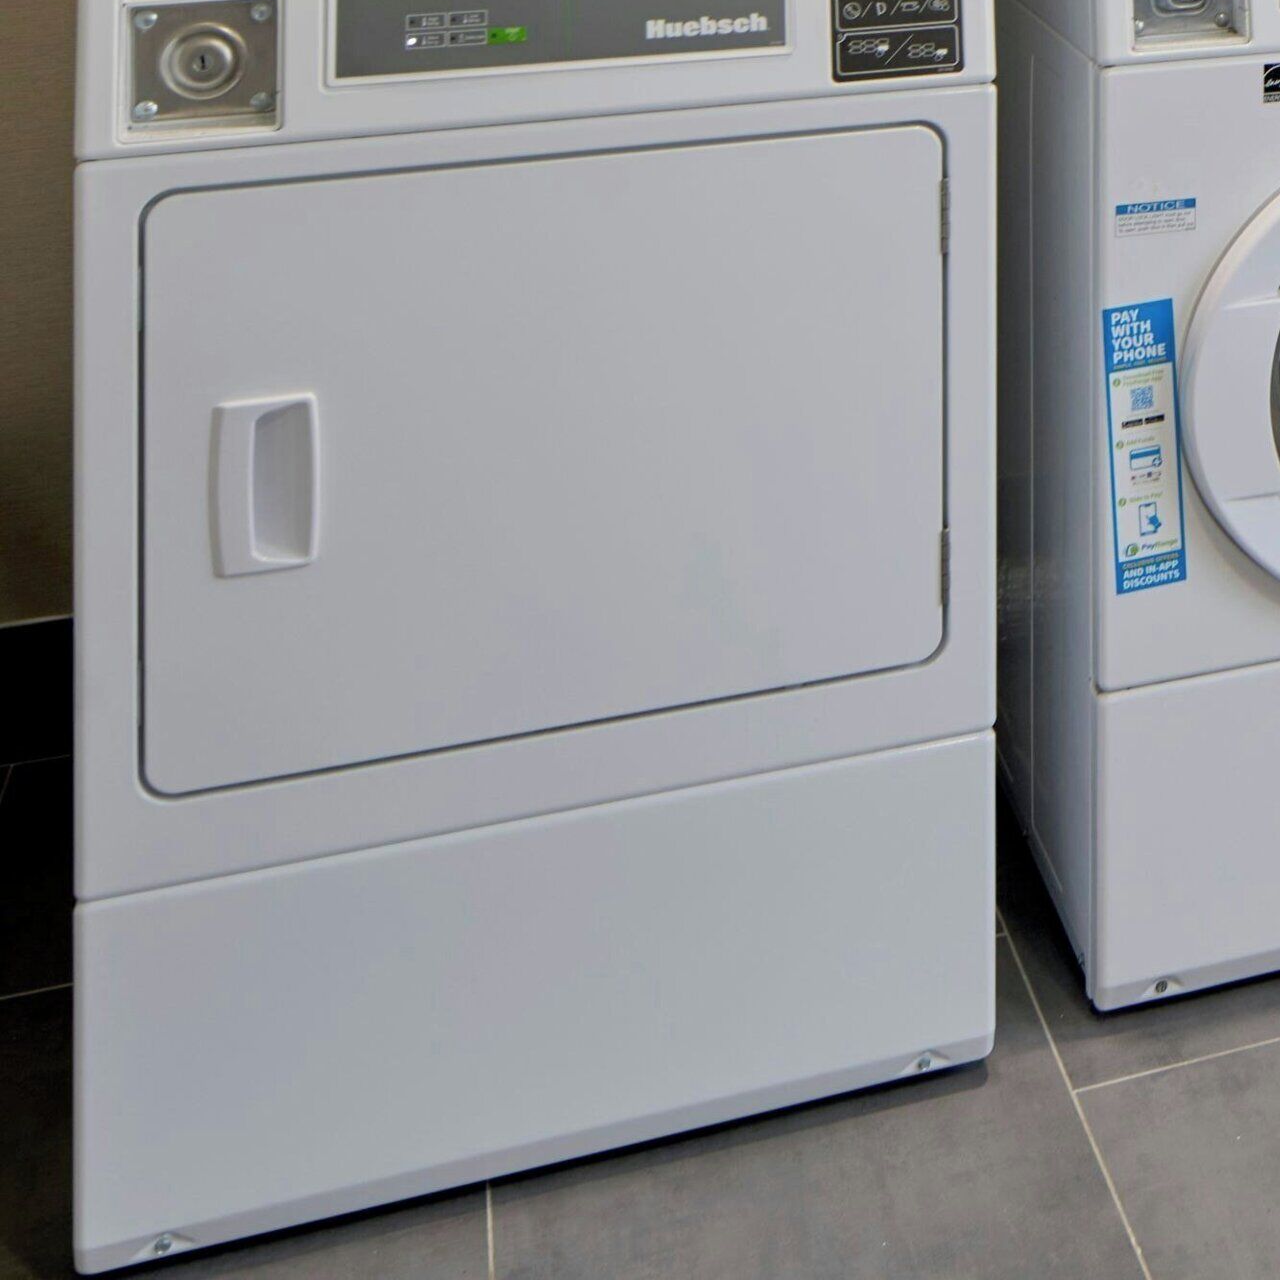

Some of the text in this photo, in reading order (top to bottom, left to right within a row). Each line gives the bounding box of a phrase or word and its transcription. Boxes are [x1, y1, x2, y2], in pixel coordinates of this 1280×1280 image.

[646, 13, 768, 40] Huebsch
[1127, 201, 1184, 214] NOTICE
[1111, 308, 1139, 325] PAY
[1112, 319, 1151, 338] WITH
[1112, 332, 1154, 351] YOUR
[1113, 342, 1166, 364] PHONE
[1123, 568, 1143, 579] AND
[1146, 560, 1178, 575] IN-APP
[1123, 569, 1180, 590] DISCOUNTS
